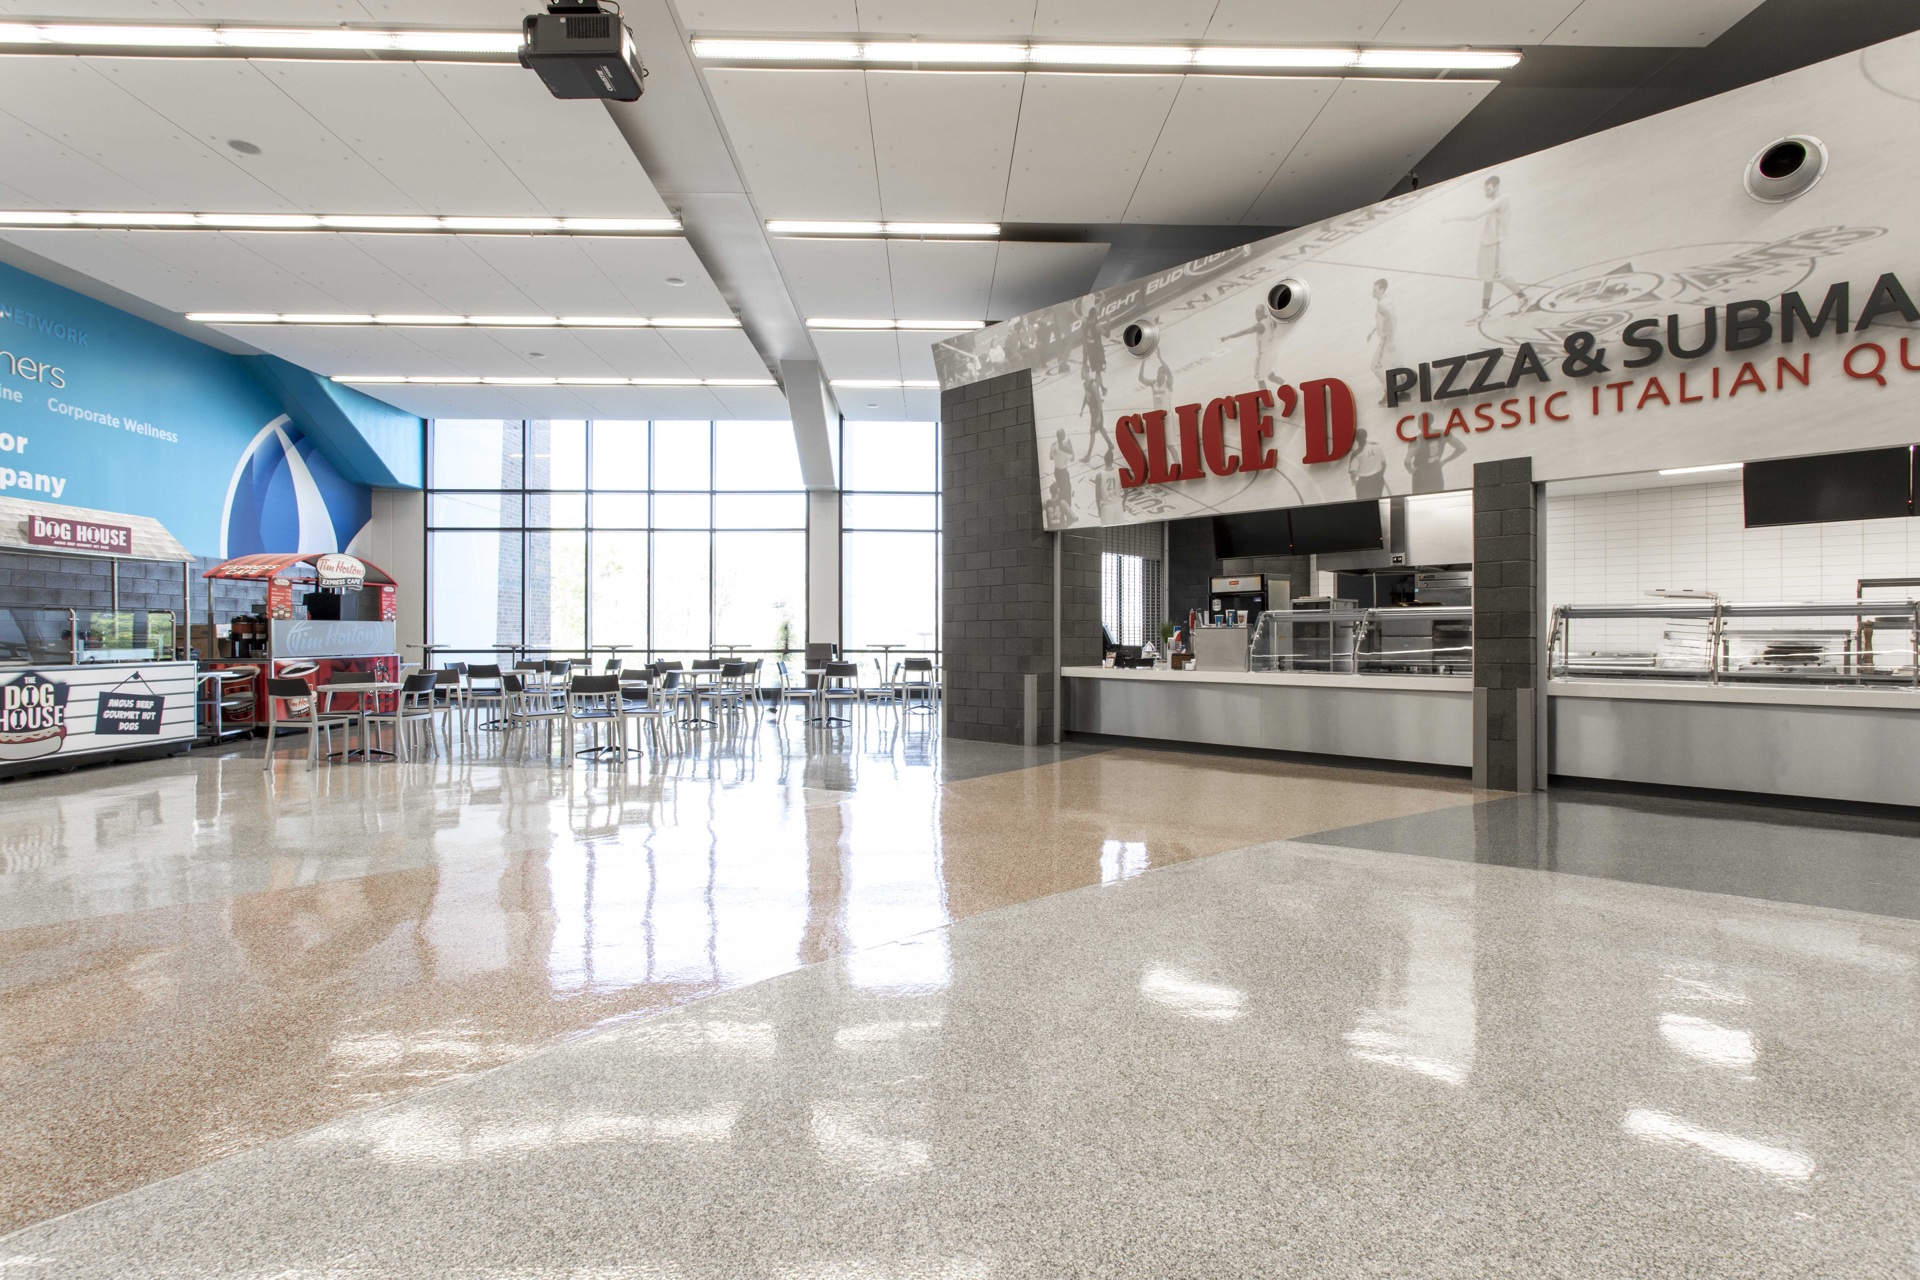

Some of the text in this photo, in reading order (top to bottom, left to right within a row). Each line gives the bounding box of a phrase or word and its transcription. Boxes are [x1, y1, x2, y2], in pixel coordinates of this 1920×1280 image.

[1145, 267, 1184, 296] BUD
[1097, 289, 1140, 320] IGHT
[0, 303, 89, 348] NETWORK
[1386, 272, 1920, 408] PIZZA & SUBMA
[1395, 390, 1569, 442] CLASSIC
[1592, 352, 1810, 415] ITALIAN
[47, 397, 120, 428] Corporate
[123, 416, 179, 443] Wellness
[1115, 377, 1357, 489] SLICE'D
[0, 432, 28, 454] or
[0, 466, 67, 499] pany
[34, 520, 127, 550] DOG HOUSE
[319, 558, 365, 576] Tim Hortons
[321, 578, 346, 586] EXPRESS
[291, 625, 321, 654] Tim
[24, 676, 37, 685] THE
[5, 683, 55, 711] DOG
[107, 698, 155, 709] ANGUS BEEF
[102, 710, 157, 720] GOURMET HOT
[118, 722, 140, 731] DOGS
